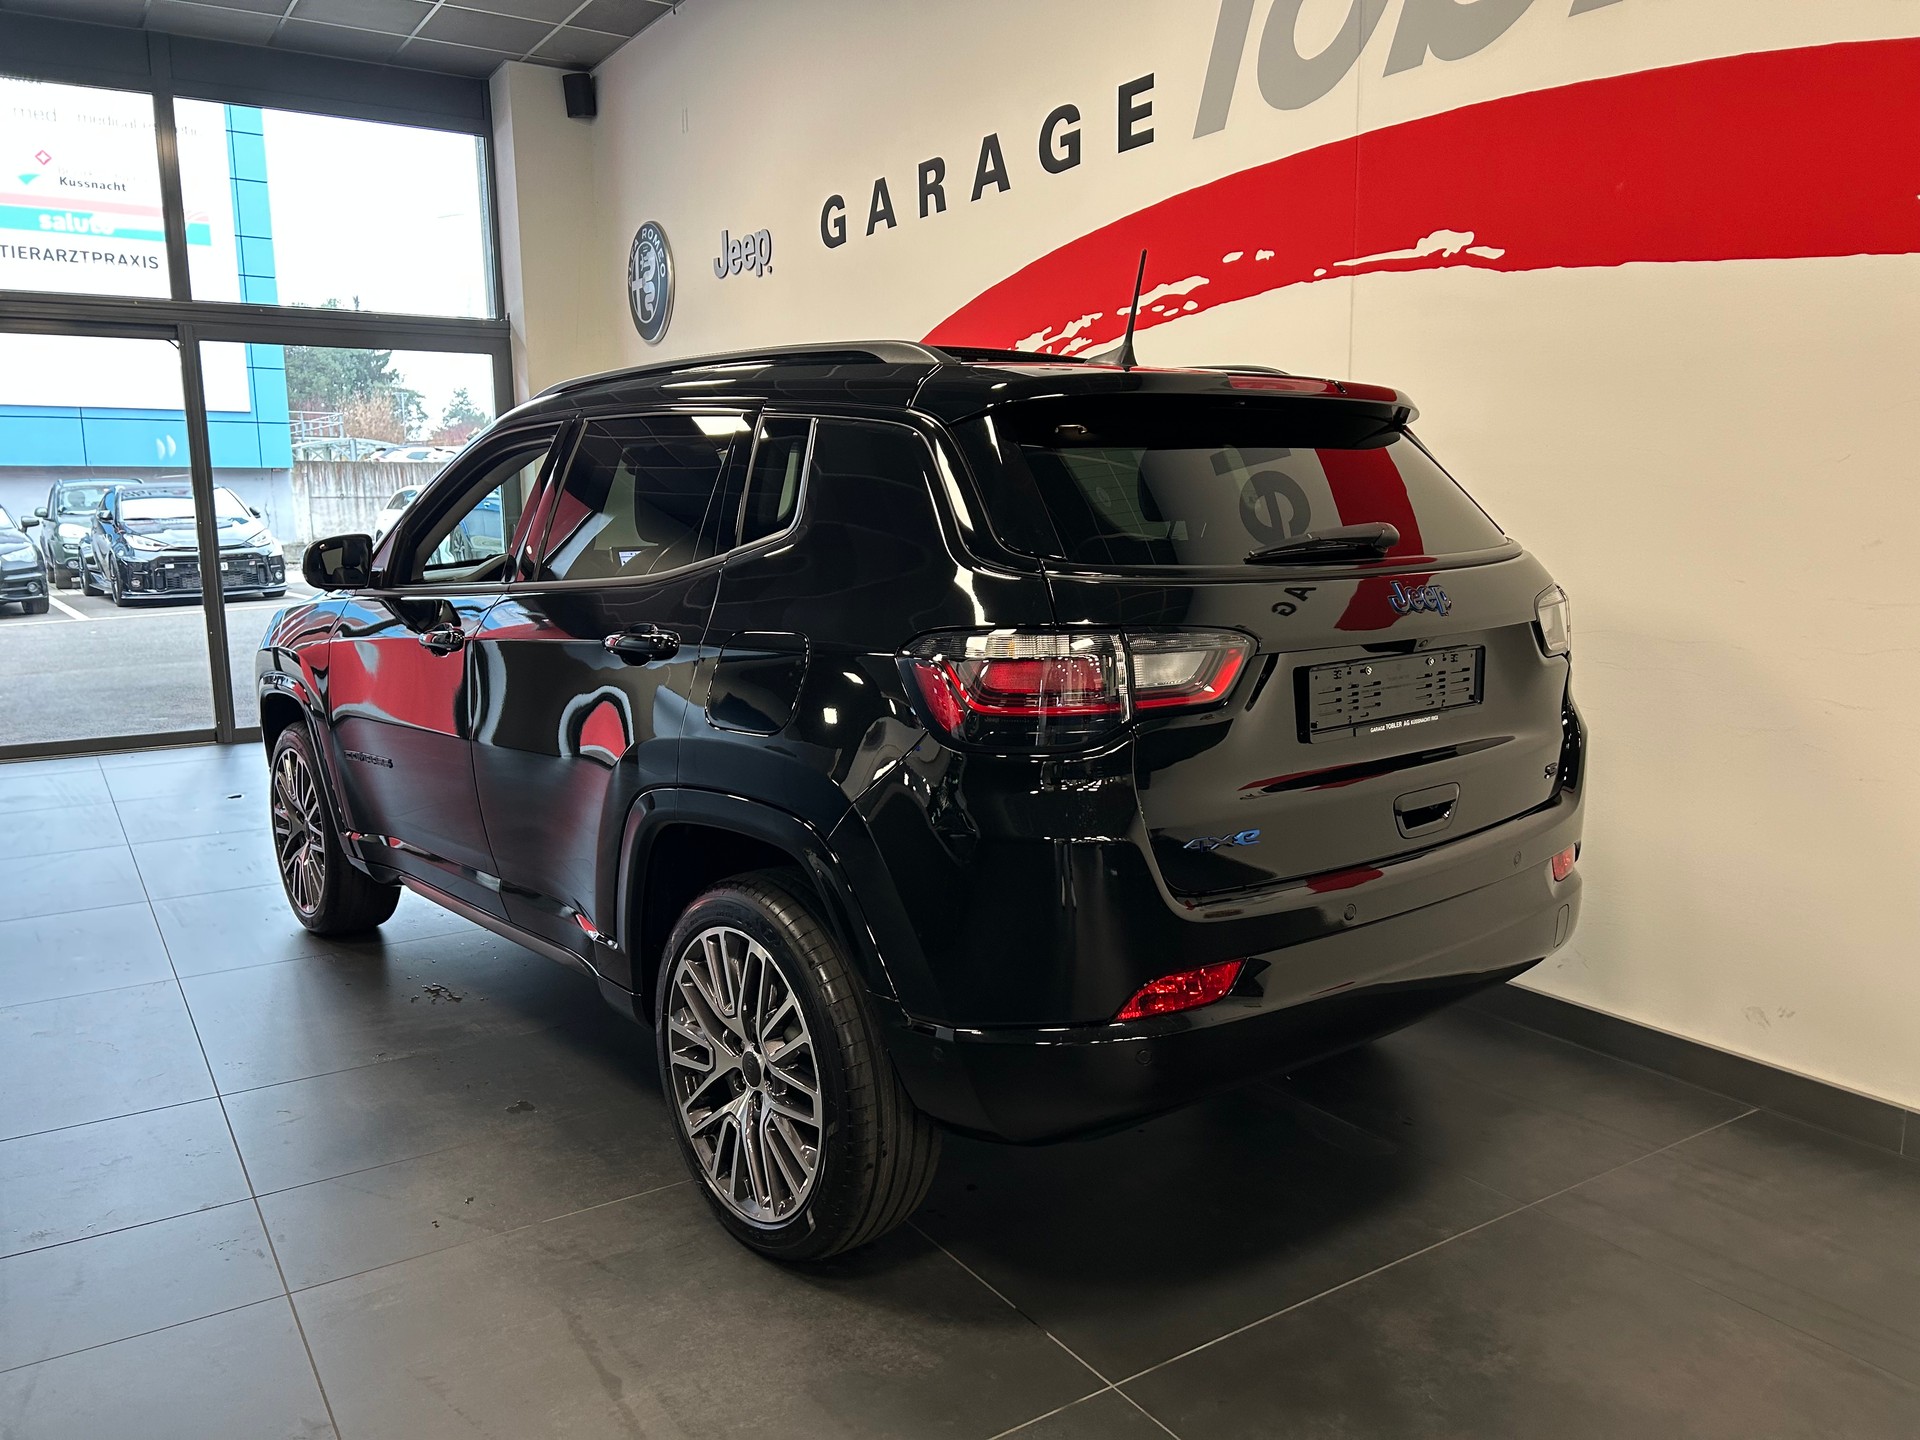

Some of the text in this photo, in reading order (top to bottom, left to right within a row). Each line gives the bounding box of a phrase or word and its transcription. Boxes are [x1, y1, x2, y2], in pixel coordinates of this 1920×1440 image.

[820, 72, 1155, 249] GARAGE
[0, 244, 159, 270] TIERARZTPRAXIS
[641, 227, 666, 278] ROMEO
[713, 228, 772, 280] Jeep
[1387, 580, 1452, 617] Jeep
[1386, 720, 1403, 730] TOBLER
